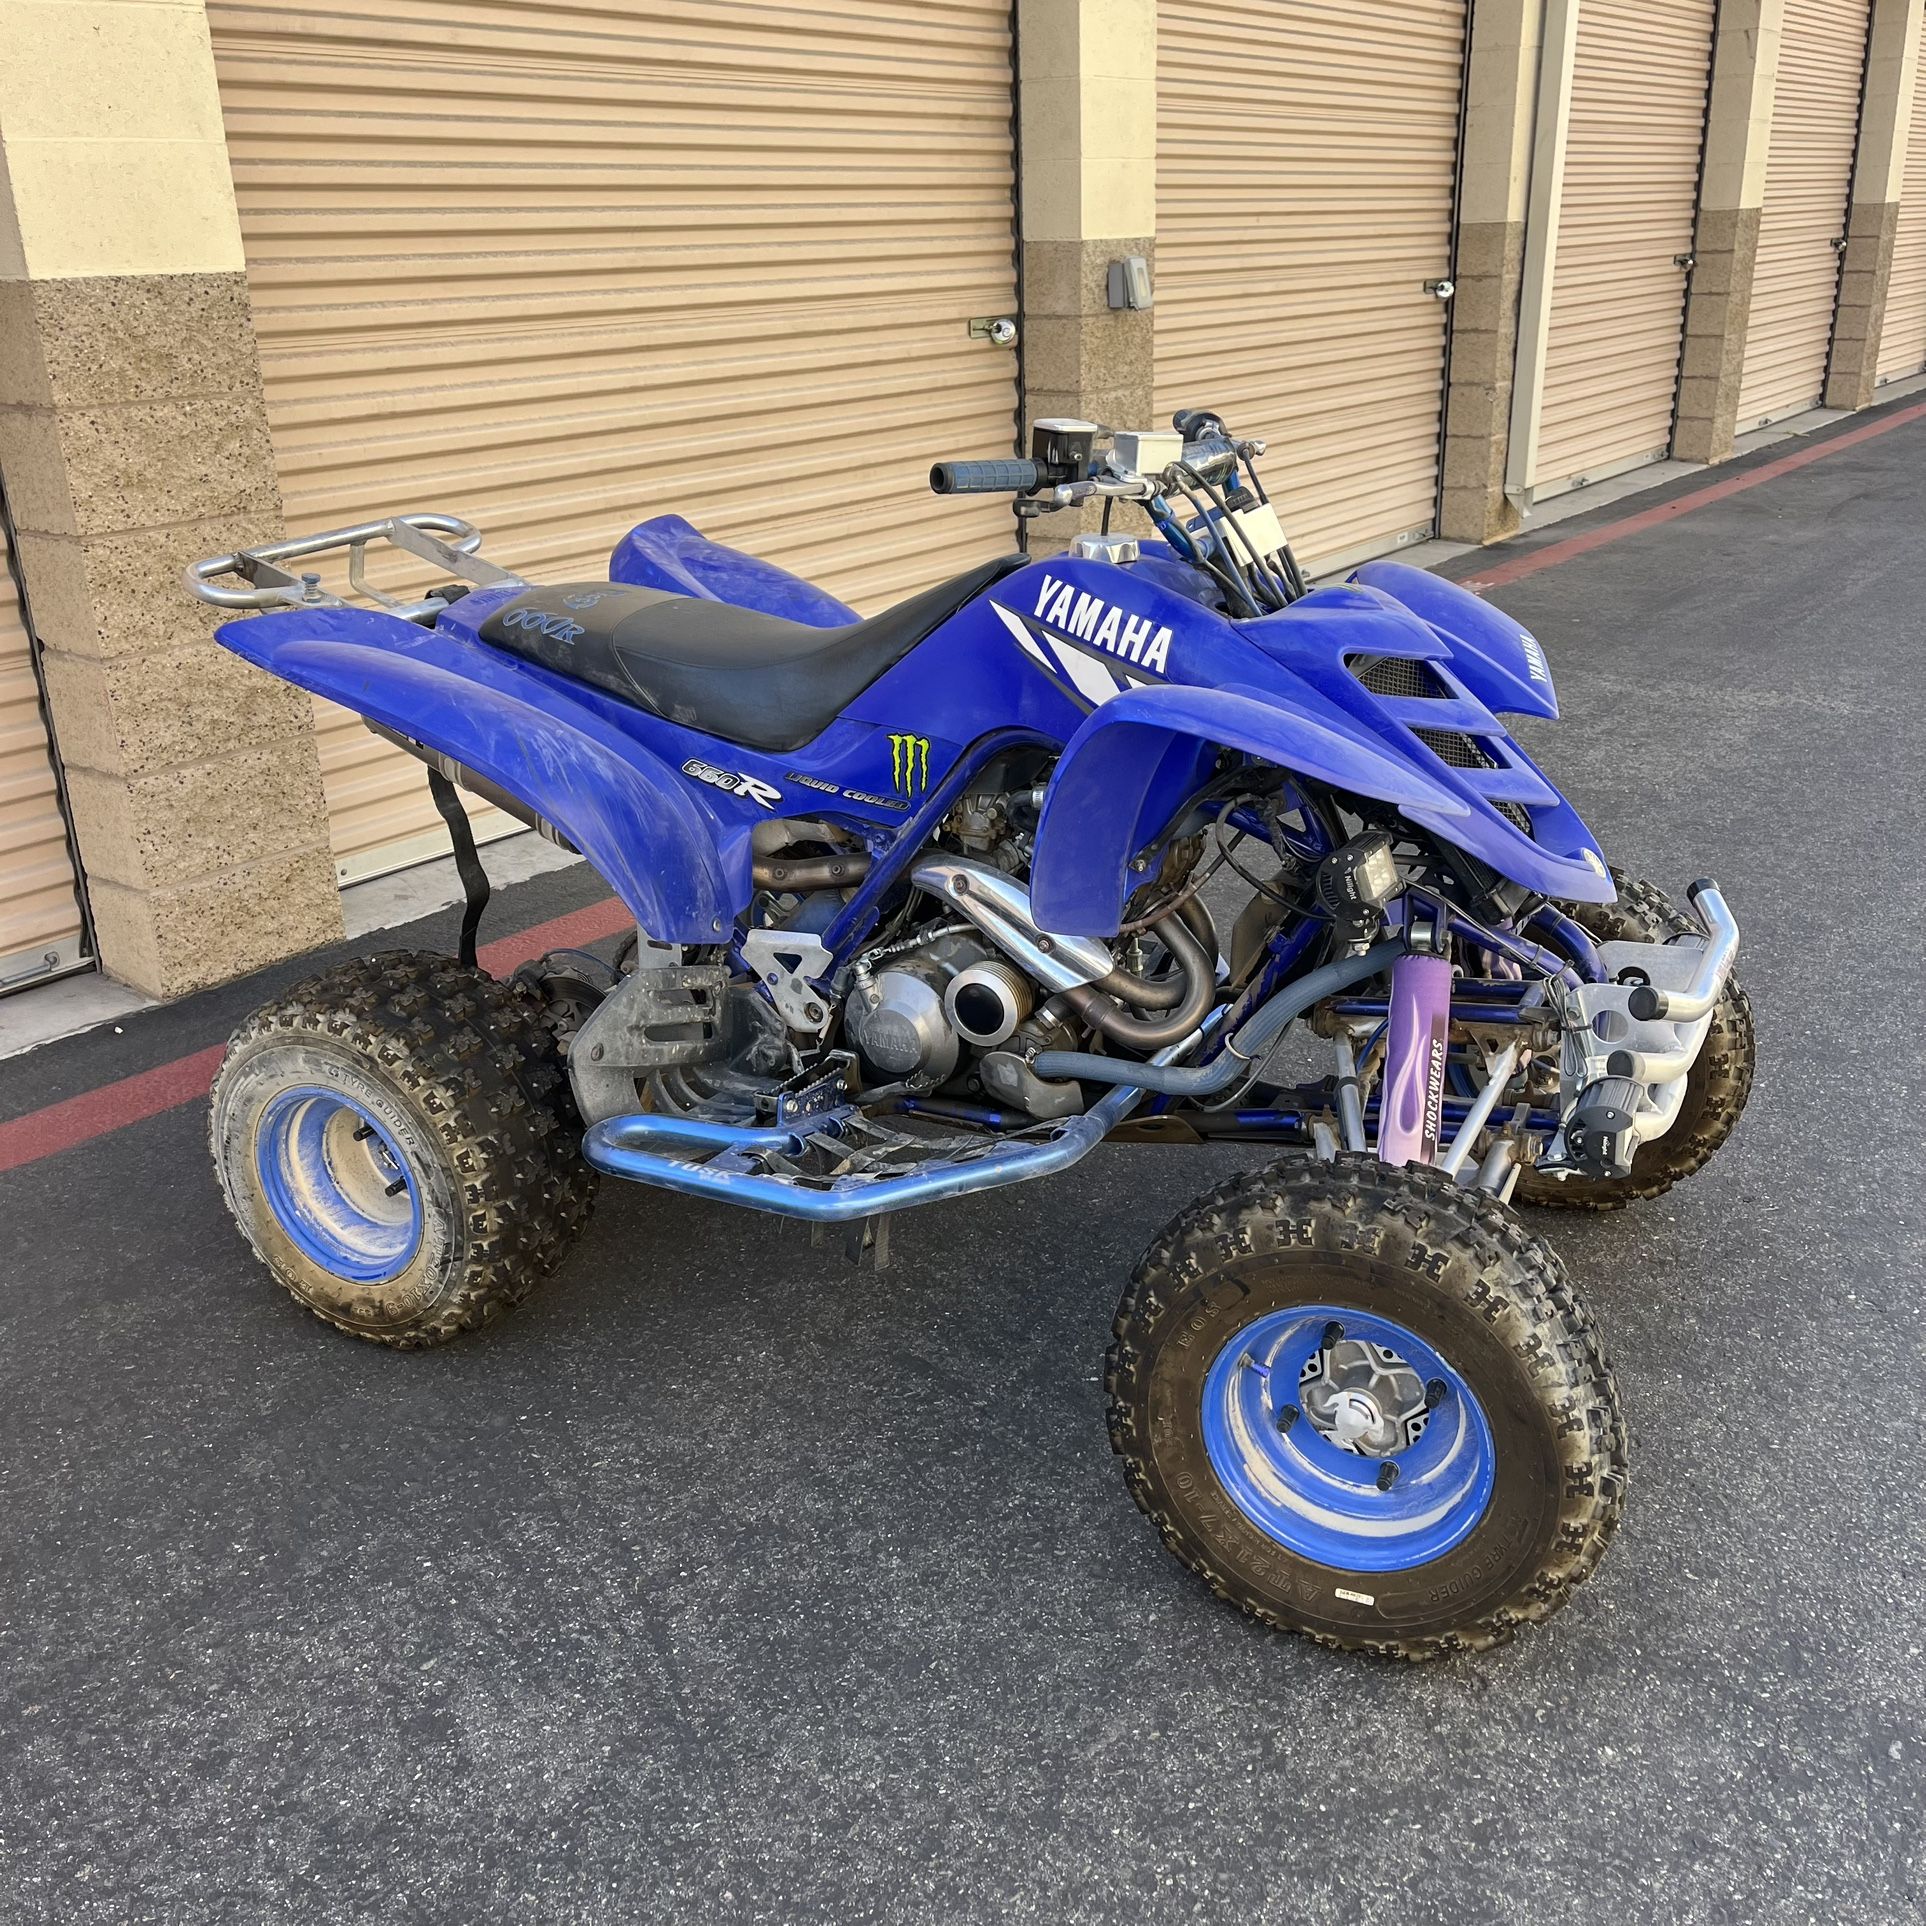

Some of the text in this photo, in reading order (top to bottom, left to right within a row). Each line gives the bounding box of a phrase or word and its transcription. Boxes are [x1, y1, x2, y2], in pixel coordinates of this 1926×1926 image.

[1034, 574, 1173, 674] YAMAHA
[1519, 633, 1548, 683] YAMAHA
[681, 758, 782, 811] 660R
[785, 772, 909, 810] LIQUID COOLED
[1345, 875, 1357, 900] Nilight
[863, 1026, 919, 1055] YAMAHA
[342, 1072, 417, 1147] TYRE GUIDER
[1424, 1038, 1443, 1141] SHOCKWEARS
[1428, 1534, 1512, 1601] TYRE GUIDER
